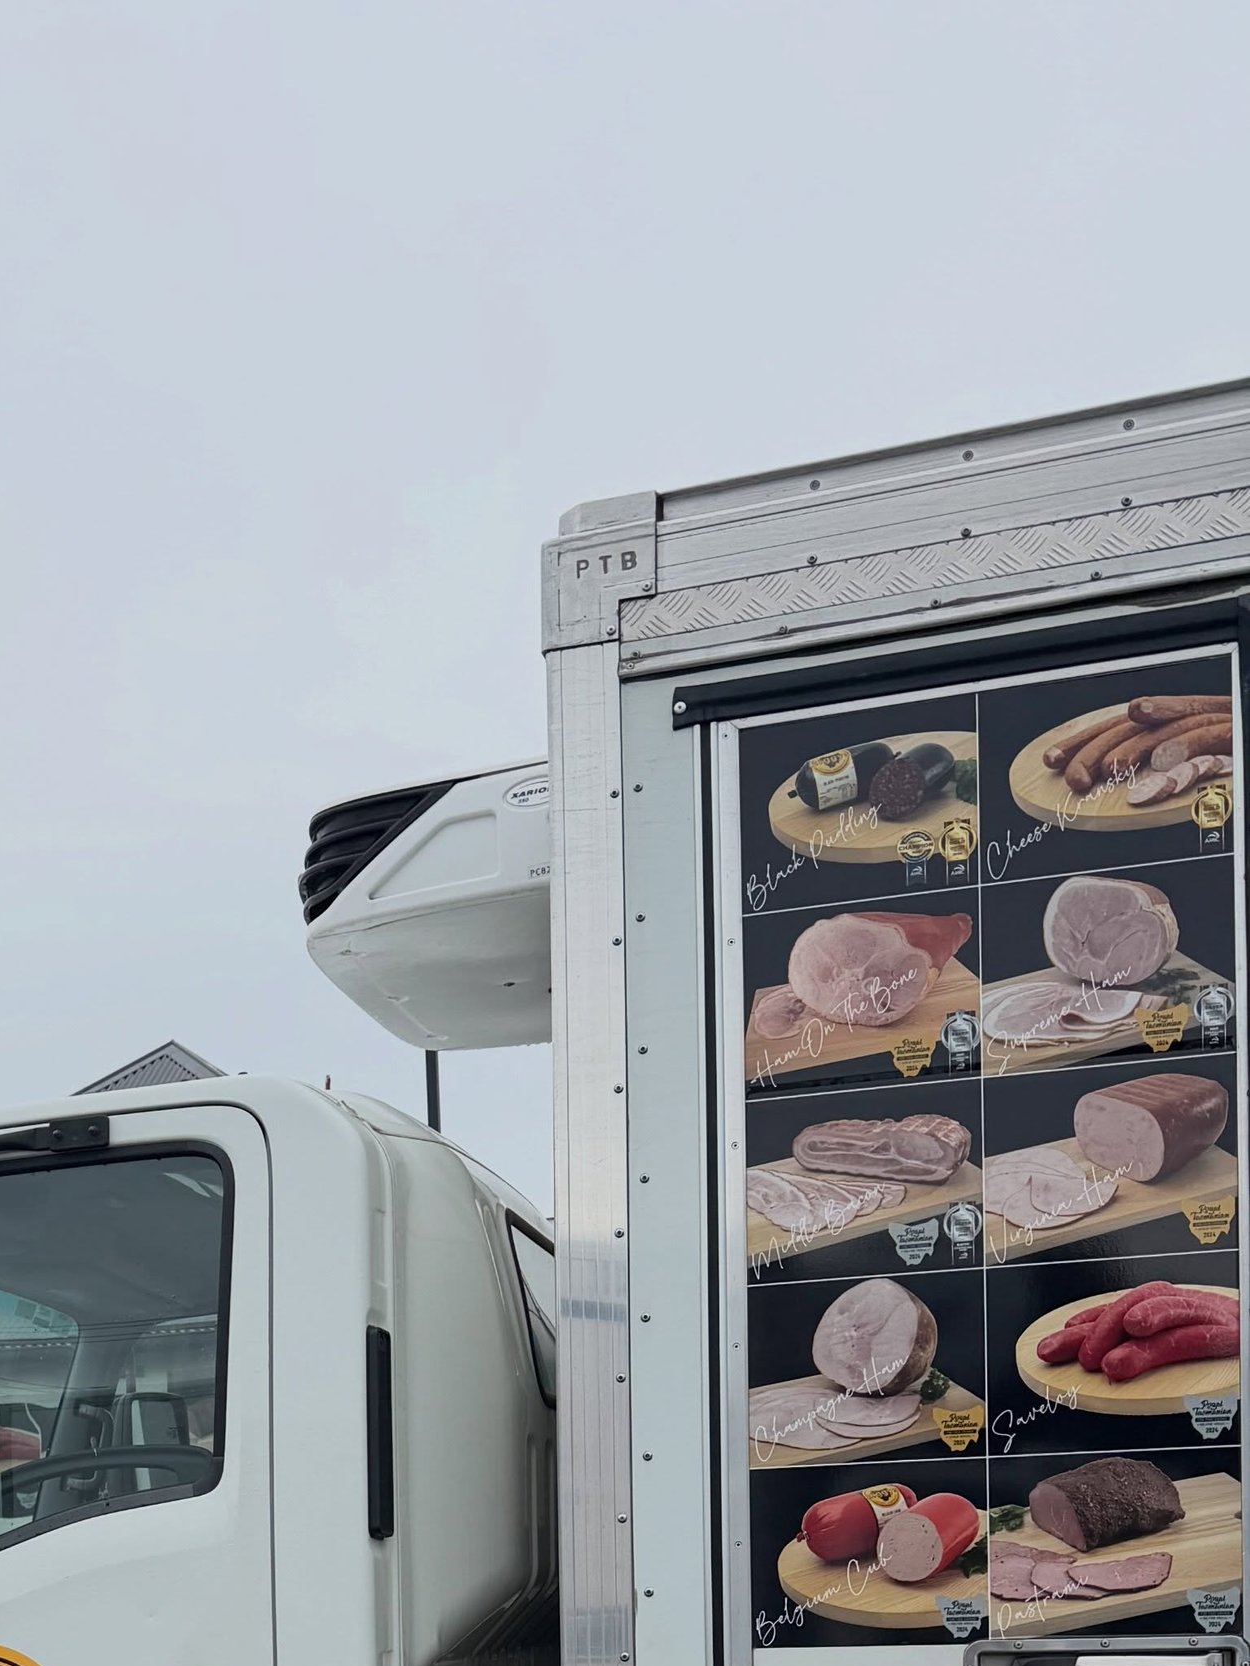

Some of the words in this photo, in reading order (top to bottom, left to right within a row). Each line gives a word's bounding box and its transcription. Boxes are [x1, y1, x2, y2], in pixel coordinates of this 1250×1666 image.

[575, 550, 638, 579] PTB
[746, 844, 805, 911] Black
[809, 803, 882, 869] Pudding
[986, 821, 1052, 880] Cheese
[1056, 757, 1140, 832] Kransky
[750, 1046, 801, 1088] Ham
[801, 1017, 836, 1058] On
[830, 991, 869, 1033] The
[869, 967, 918, 1014] Bone
[986, 1005, 1072, 1076] Supreme
[1075, 965, 1132, 1012] Ham
[751, 1216, 822, 1280] Middle
[824, 1182, 886, 1235] Bacon
[989, 1200, 1072, 1263] Virginia
[1076, 1159, 1133, 1207] Ham
[754, 1387, 855, 1462] Champagne
[857, 1355, 909, 1396] Ham
[991, 1384, 1081, 1453] Saveloy
[755, 1584, 841, 1646] Belgium
[846, 1542, 893, 1597] Cub
[997, 1574, 1089, 1640] Pastrami
